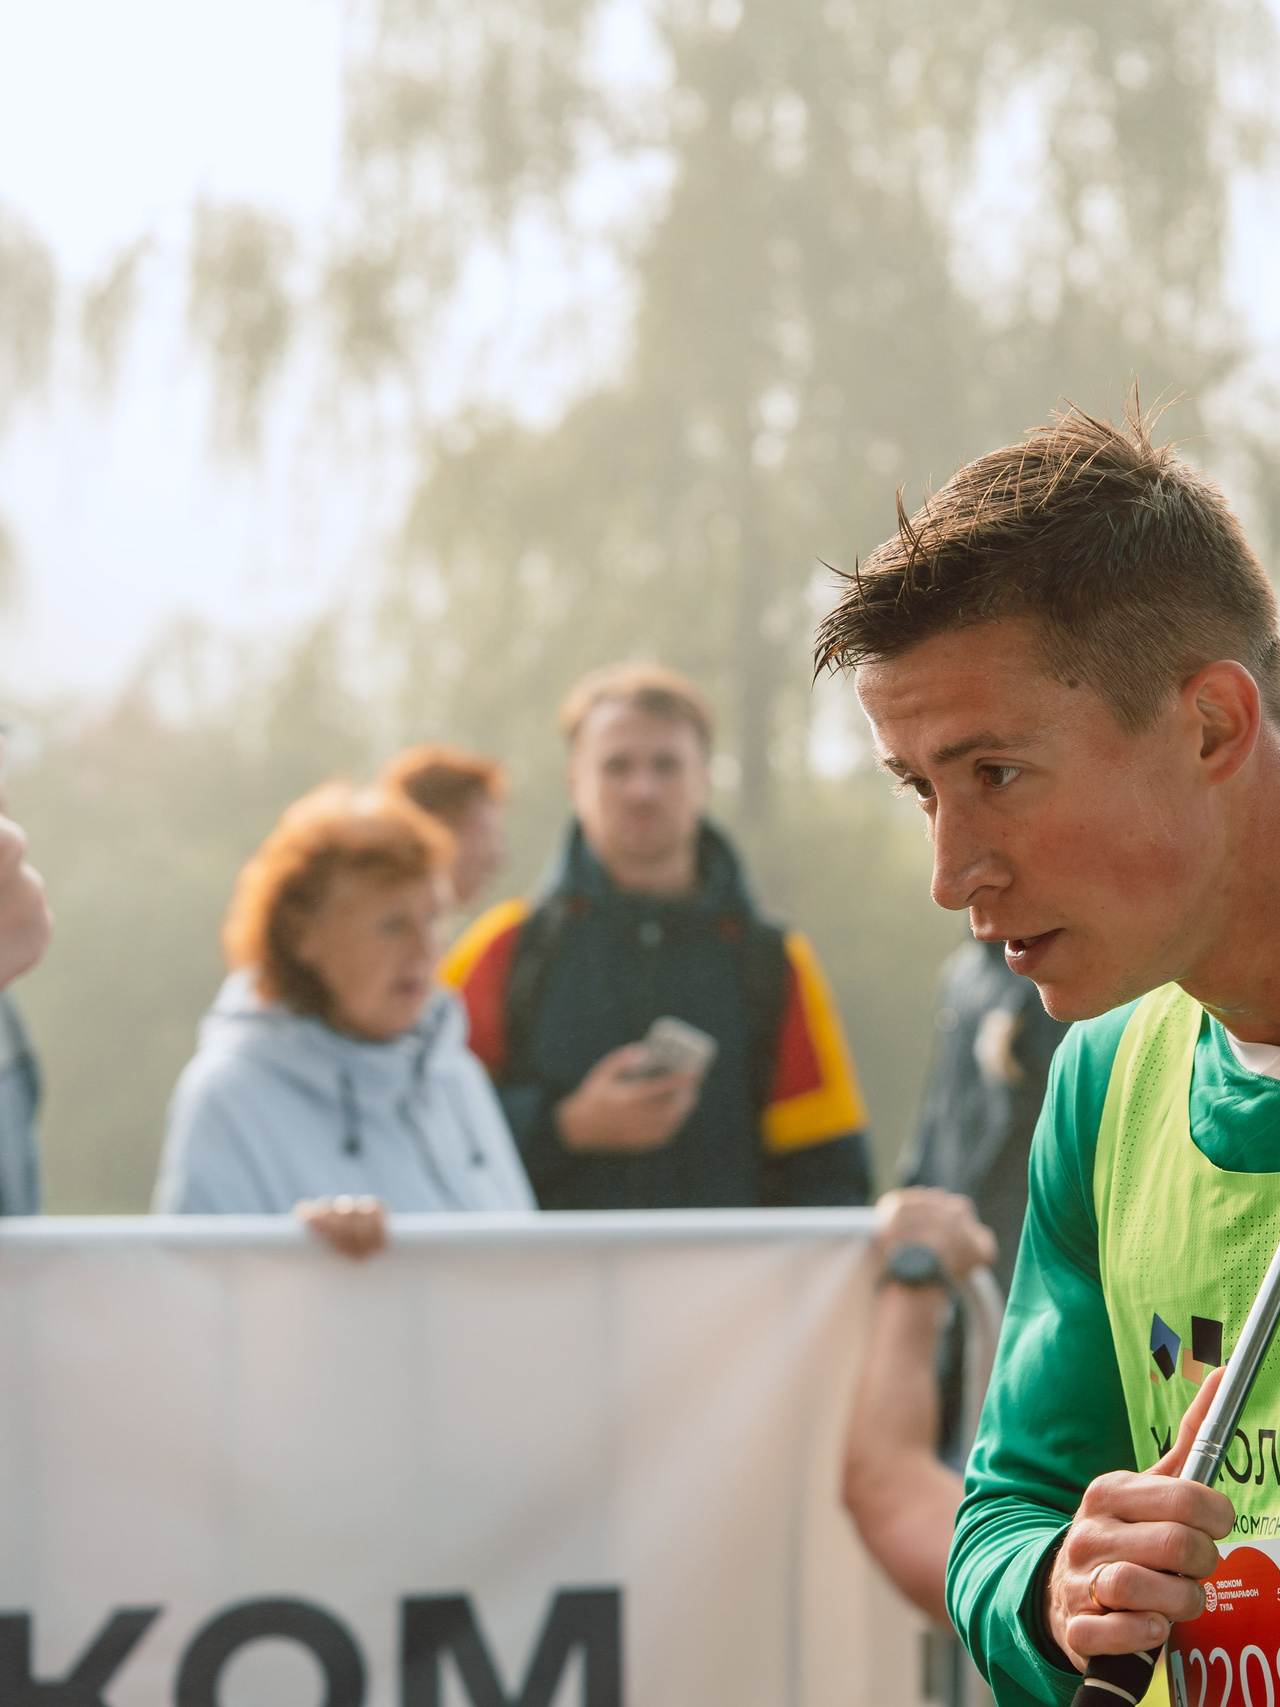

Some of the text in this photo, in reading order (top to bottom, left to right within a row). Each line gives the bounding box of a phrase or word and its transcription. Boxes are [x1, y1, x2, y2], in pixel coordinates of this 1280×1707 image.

[1216, 1579, 1243, 1589] ЗВОКОМ
[1217, 1588, 1259, 1600] ПОЛУМАРАФОН
[1219, 1603, 1234, 1611] ТУЛА
